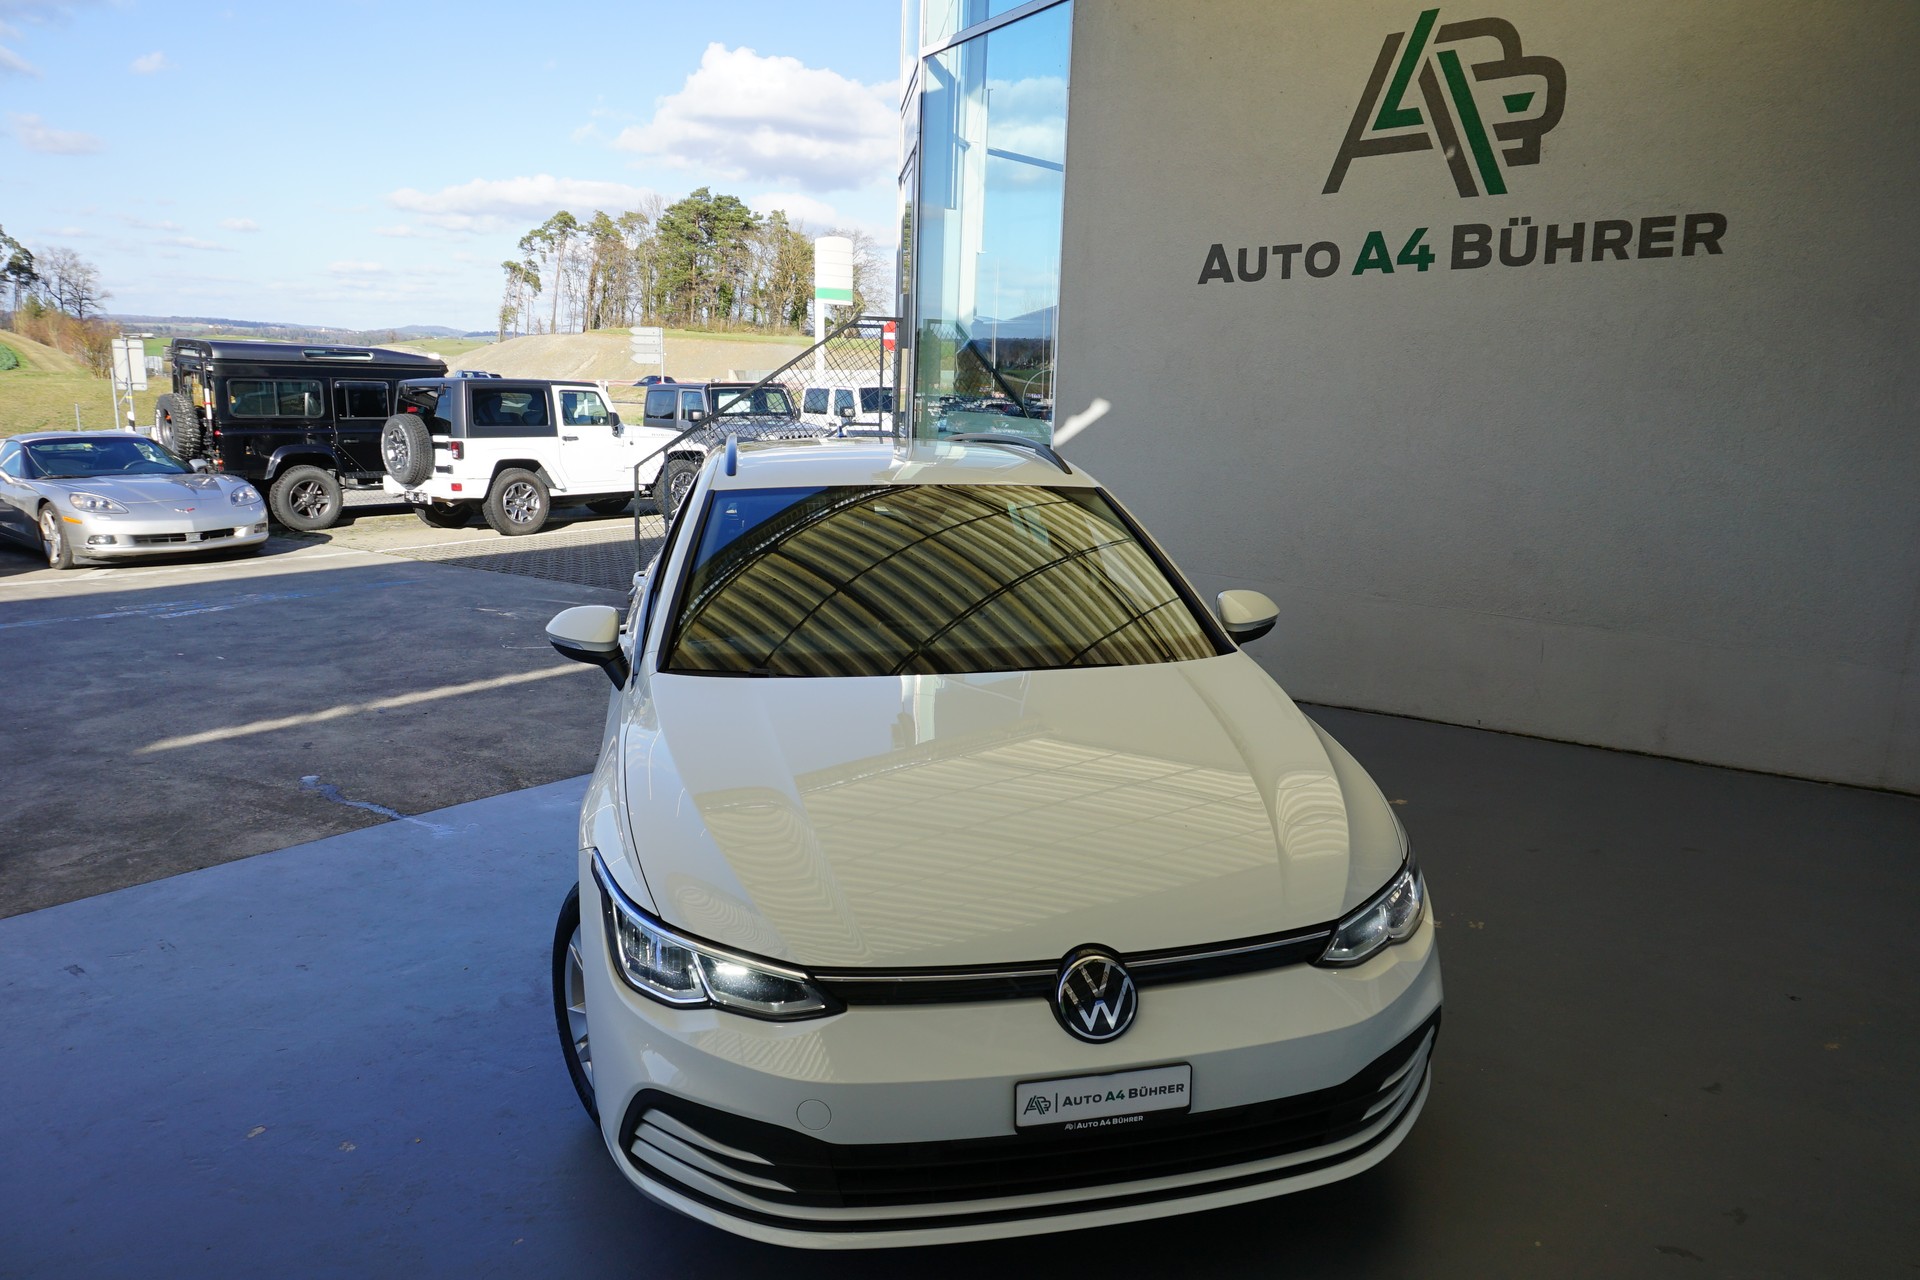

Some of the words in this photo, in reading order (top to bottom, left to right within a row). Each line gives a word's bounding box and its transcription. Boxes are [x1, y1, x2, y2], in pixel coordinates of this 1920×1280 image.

[1198, 241, 1340, 285] AUTO
[1352, 227, 1435, 276] A4
[1451, 213, 1727, 270] BÜHRER
[1062, 1094, 1102, 1107] AUTO
[1105, 1089, 1125, 1102] A4
[1128, 1083, 1185, 1099] BÜHRER
[1076, 1121, 1099, 1129] AUTO
[1112, 1115, 1144, 1125] BÜHRER
